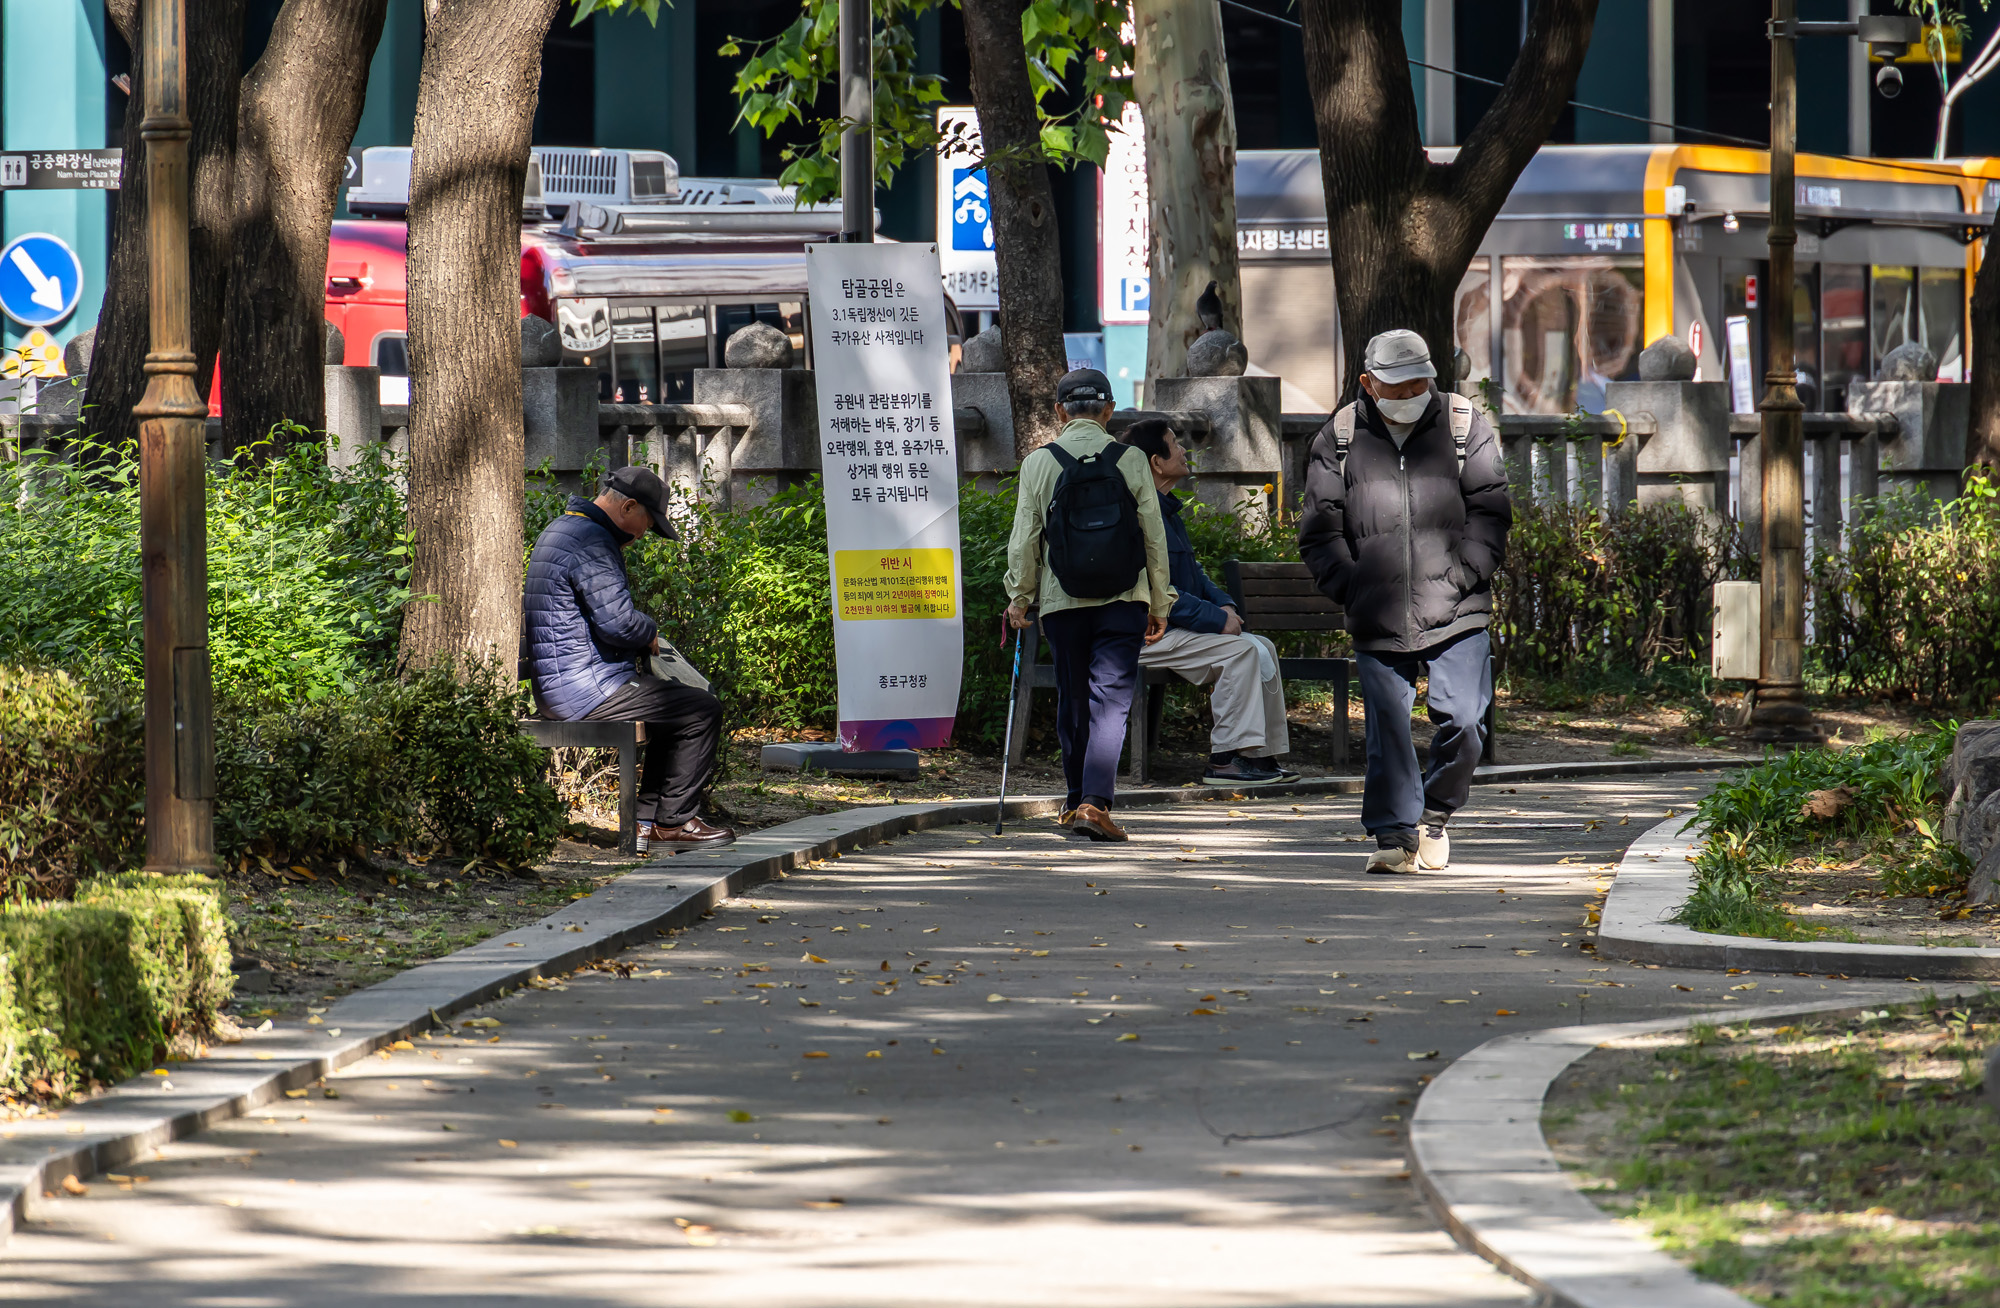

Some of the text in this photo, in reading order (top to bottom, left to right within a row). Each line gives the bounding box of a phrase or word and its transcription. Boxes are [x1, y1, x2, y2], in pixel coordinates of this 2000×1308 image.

[57, 170, 73, 178] Nam
[74, 170, 88, 178] Insa
[89, 170, 107, 178] Plaza
[841, 278, 905, 298] 탑골공원은
[832, 307, 919, 323] 3.1독립정신이 깃든
[831, 330, 924, 346] 국가유산 사적입니다
[834, 392, 933, 410] 공원내 관람분위기를
[830, 416, 941, 433] 저해하는 바둑, 장기 등
[826, 439, 949, 457] 오락행위, 흡연, 음주가무,
[847, 462, 930, 480] 상거래 행위 등은
[851, 486, 929, 503] 모두 금지됩니다
[880, 556, 913, 570] 위반 시
[843, 577, 878, 587] 문화유산법
[935, 575, 948, 585] 방해
[876, 590, 890, 600] 의거
[924, 589, 950, 599] 징역이나
[845, 603, 950, 615] 2천만원 이하의 벌금에 처합니다
[879, 674, 928, 689] 종로구청장
